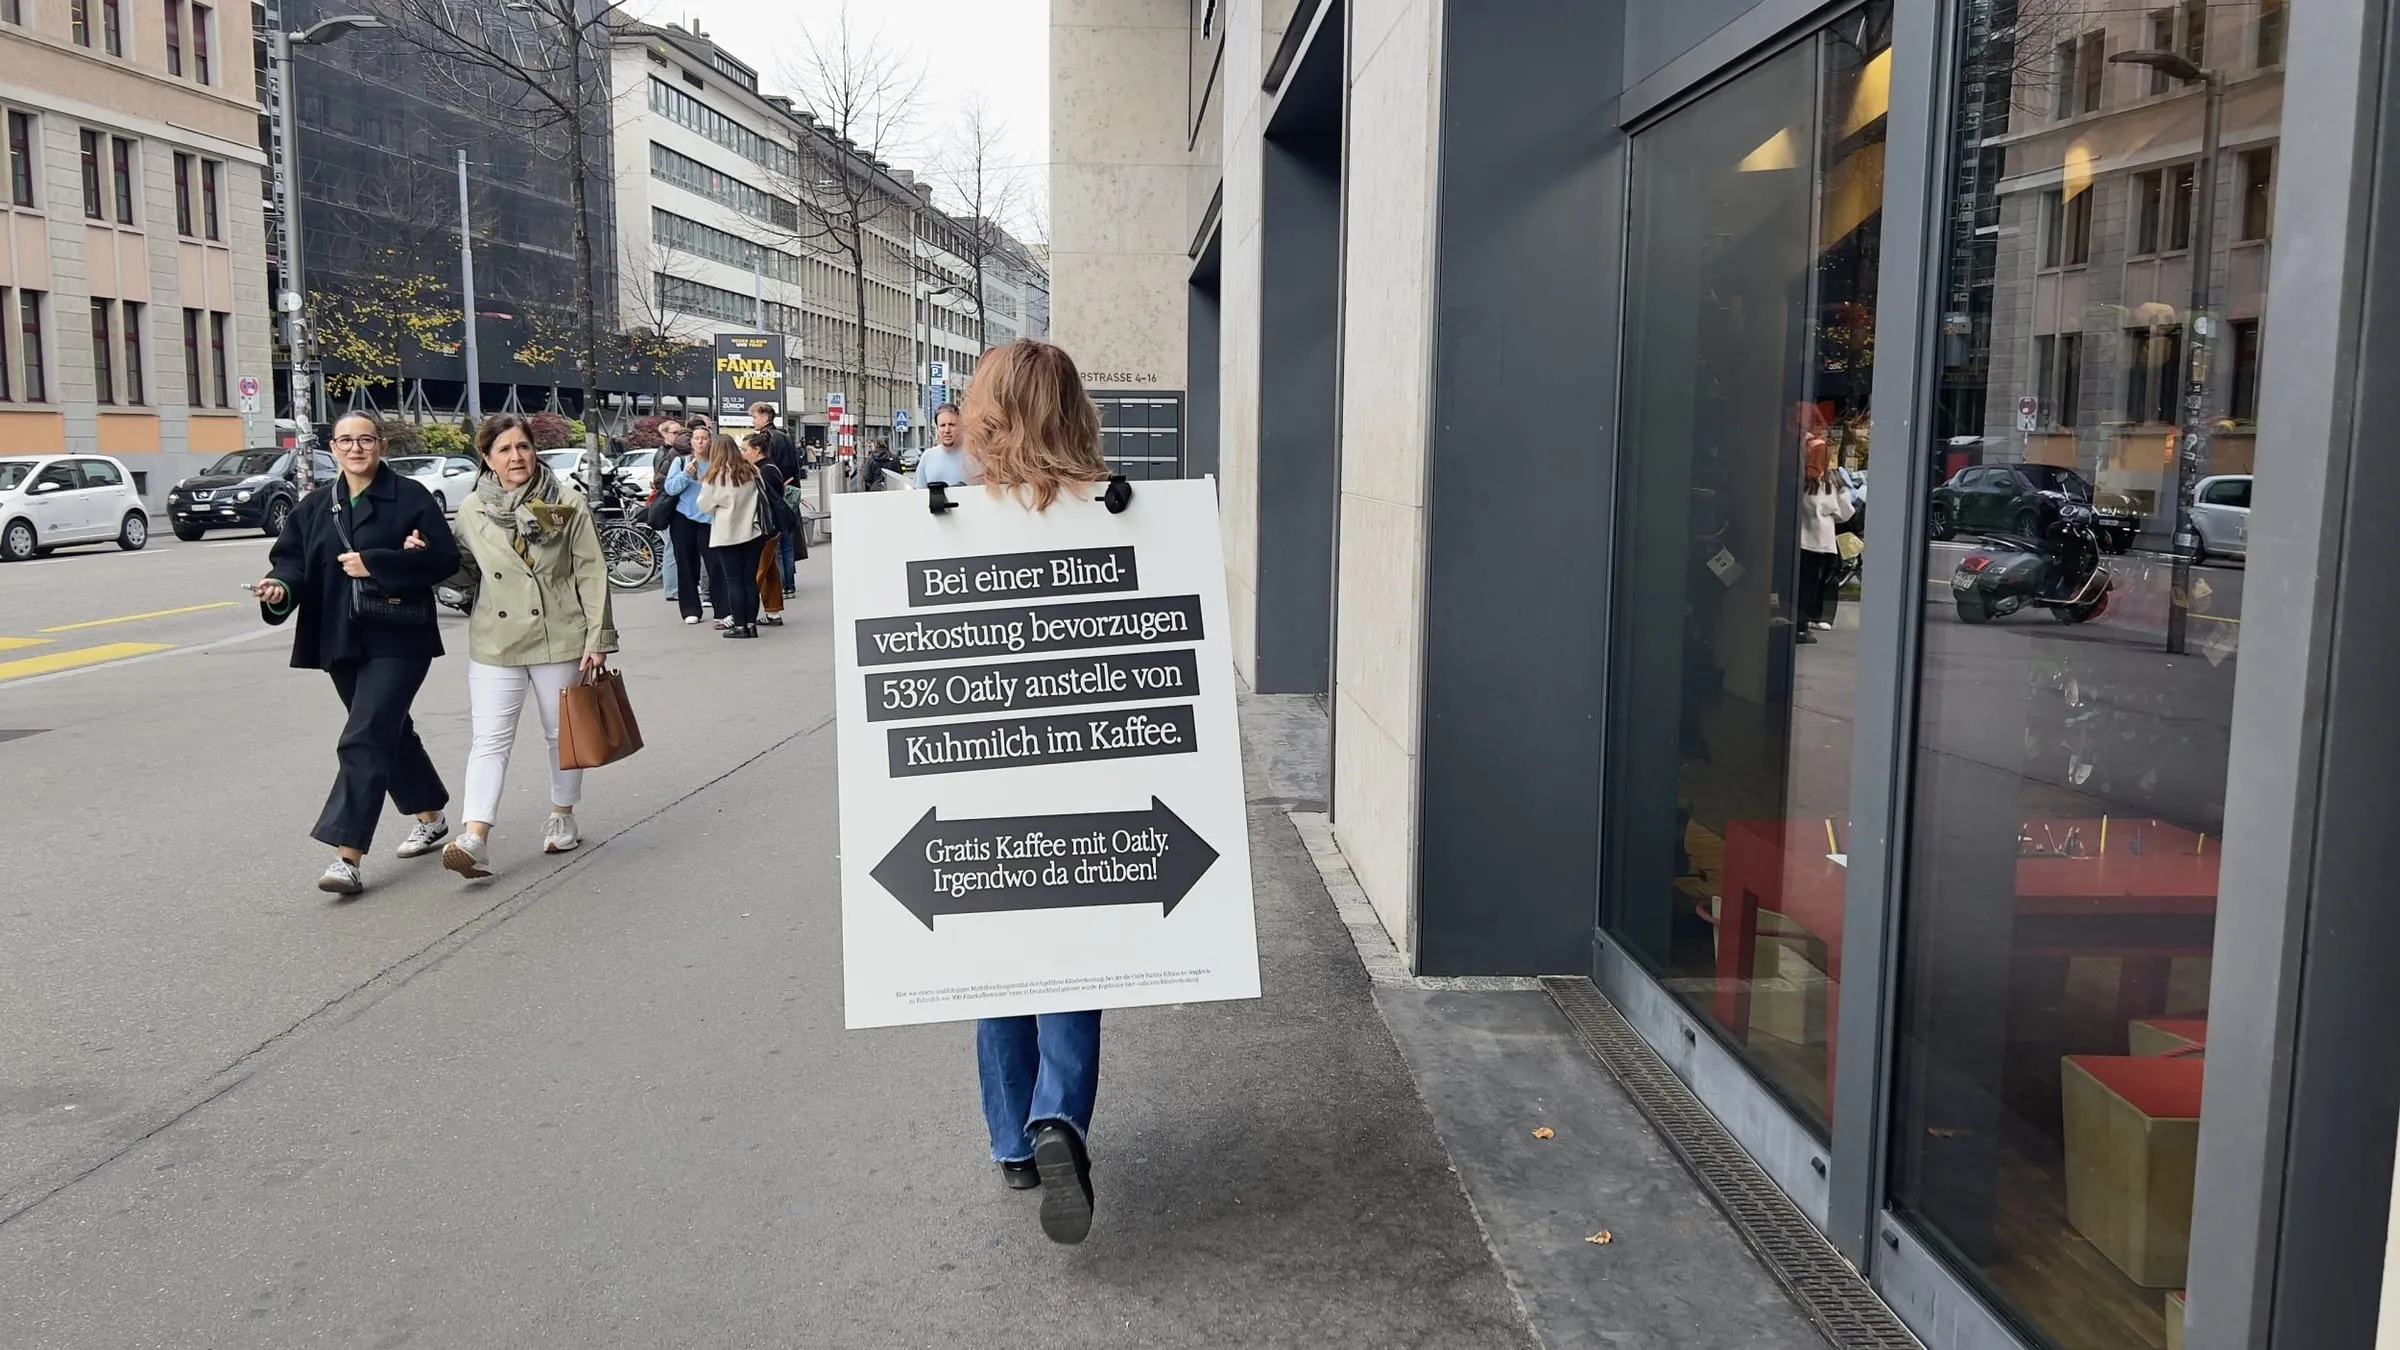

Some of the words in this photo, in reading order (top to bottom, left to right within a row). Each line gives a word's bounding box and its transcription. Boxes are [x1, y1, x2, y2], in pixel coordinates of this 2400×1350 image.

[717, 358, 775, 372] FANTA
[732, 376, 776, 390] VIER
[923, 567, 969, 596] Bei
[974, 564, 1044, 592] einer
[1050, 553, 1126, 588] Blind-
[872, 620, 1025, 654] verkostung
[1029, 611, 1188, 642] bevorzugen
[882, 678, 940, 710] 53%
[945, 670, 1019, 708] Oatly
[1025, 662, 1127, 698] anstelle
[1131, 666, 1183, 690] von
[906, 725, 1041, 766] Kuhmilch
[1046, 725, 1083, 754] im
[1088, 715, 1182, 750] Kaffee.
[925, 837, 990, 864] Gratis
[995, 831, 1067, 860] Kaffee
[1071, 831, 1108, 856] mit
[1112, 827, 1169, 858] Oatly.
[932, 861, 1037, 898] Irgendwo
[1042, 859, 1070, 886] da
[1074, 856, 1158, 884] drüben!
